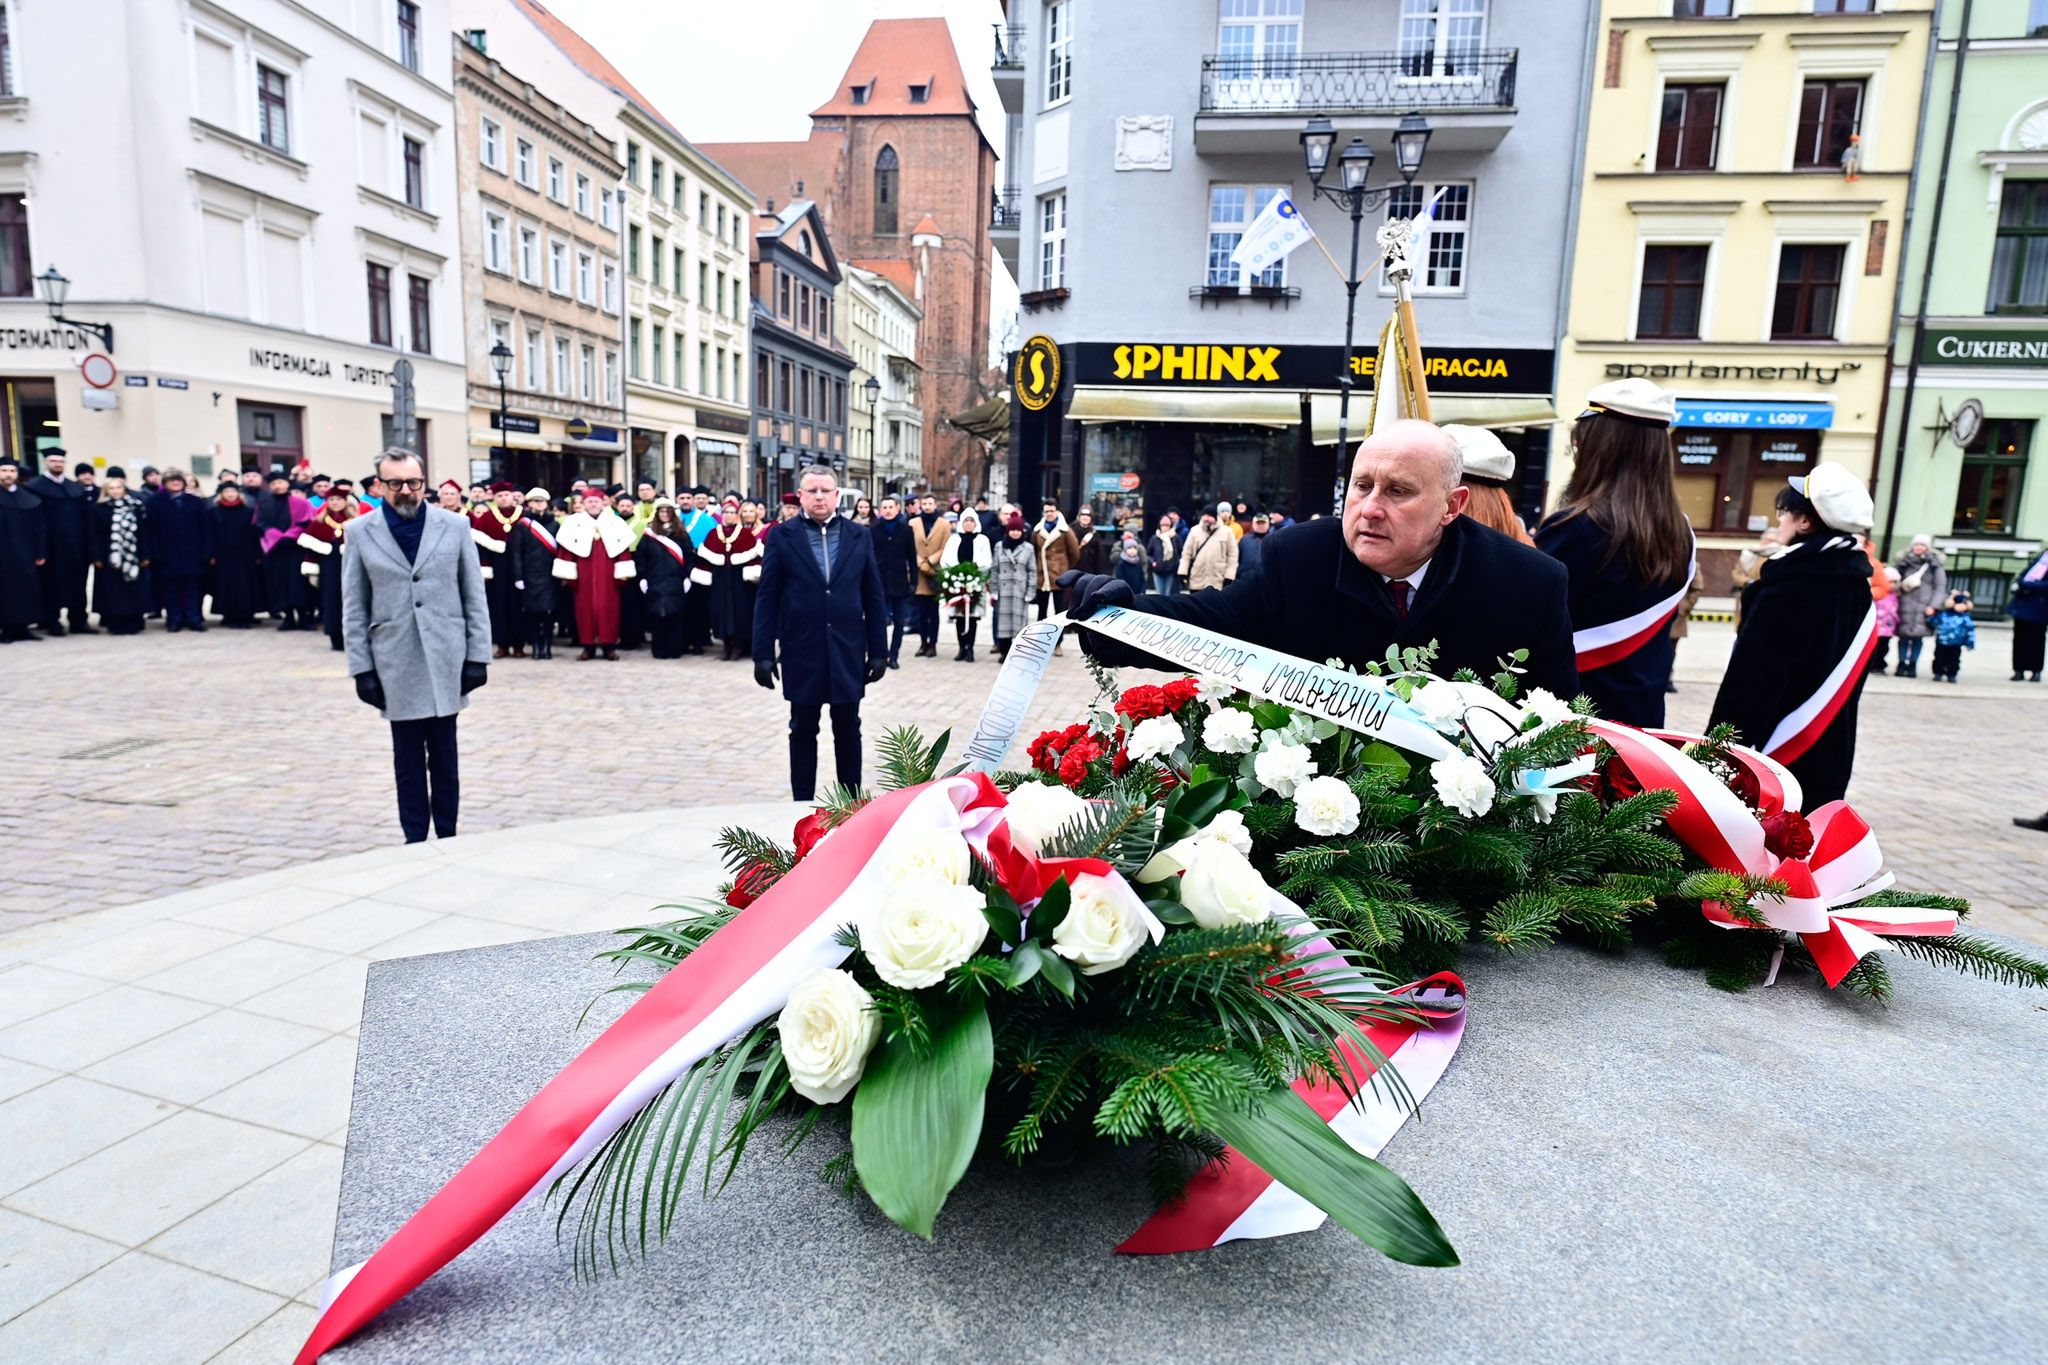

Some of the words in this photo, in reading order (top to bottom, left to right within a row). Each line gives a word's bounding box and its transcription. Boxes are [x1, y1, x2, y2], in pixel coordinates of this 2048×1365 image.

[249, 348, 332, 378] INFORMACJA
[344, 364, 412, 388] TURYSTYC
[1113, 345, 1281, 381] SPHINX
[1604, 360, 1838, 385] apartamenty
[1702, 411, 1750, 424] GOFRY
[1768, 413, 1808, 425] LODY
[1121, 615, 1258, 682] KOPERNIKOWI
